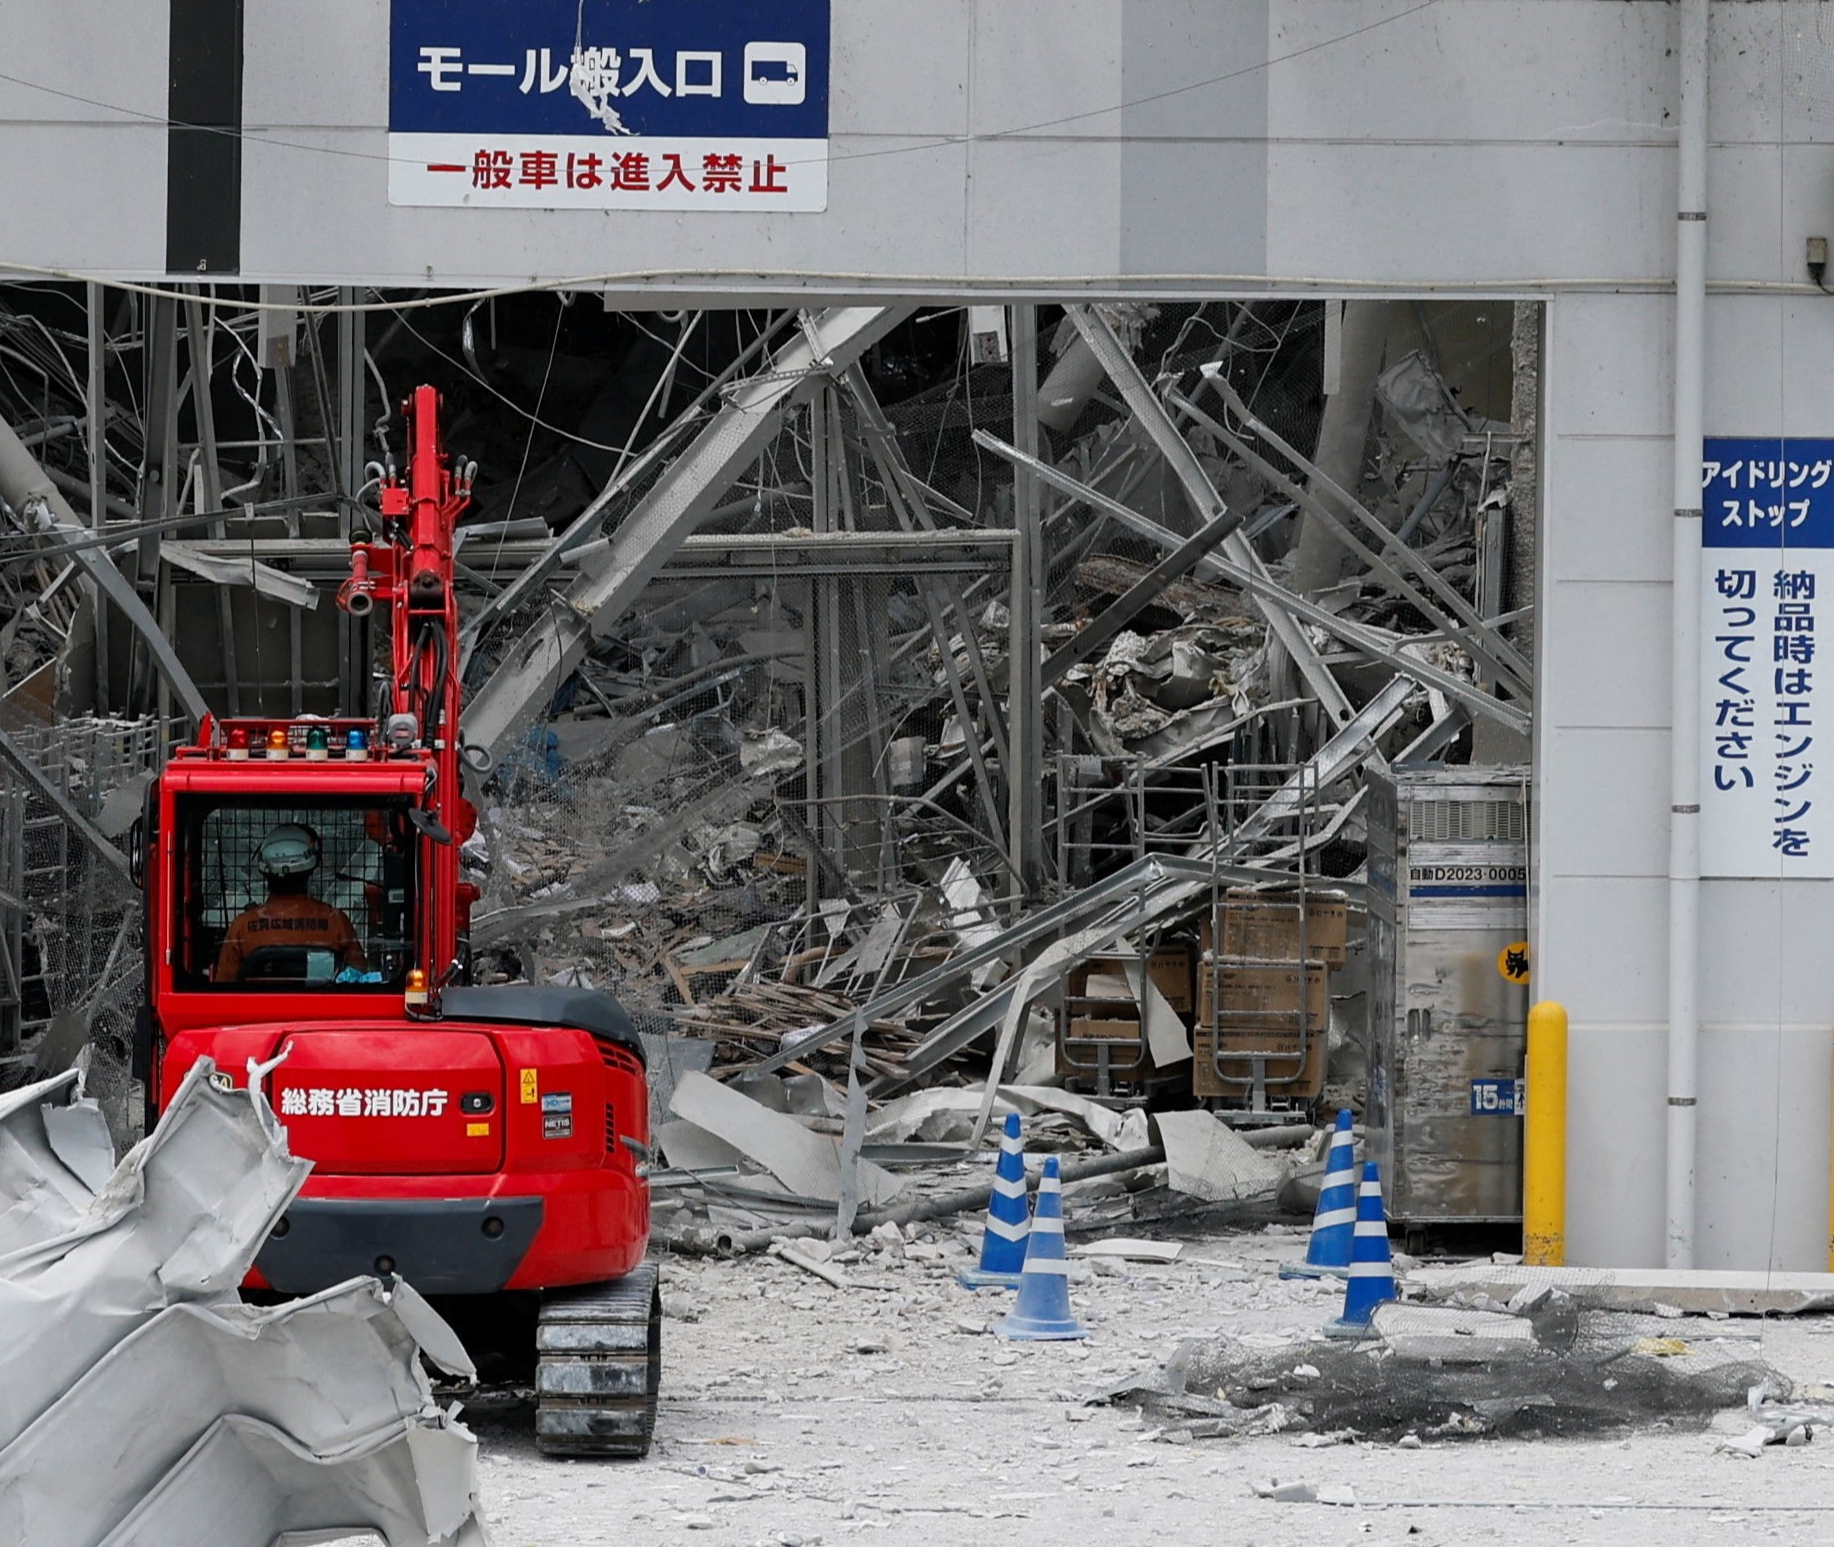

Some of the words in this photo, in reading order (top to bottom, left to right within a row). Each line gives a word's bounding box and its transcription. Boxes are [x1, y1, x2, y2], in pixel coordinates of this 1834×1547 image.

[417, 46, 723, 99] モール搬入口
[427, 149, 788, 194] 一般車は進入禁止
[1701, 459, 1833, 490] アイドリング
[1721, 499, 1811, 529] ストップ
[1714, 568, 1757, 792] 切ってください
[1772, 568, 1816, 857] 納品時はエンジンを
[280, 1087, 449, 1117] 総務省消防庁
